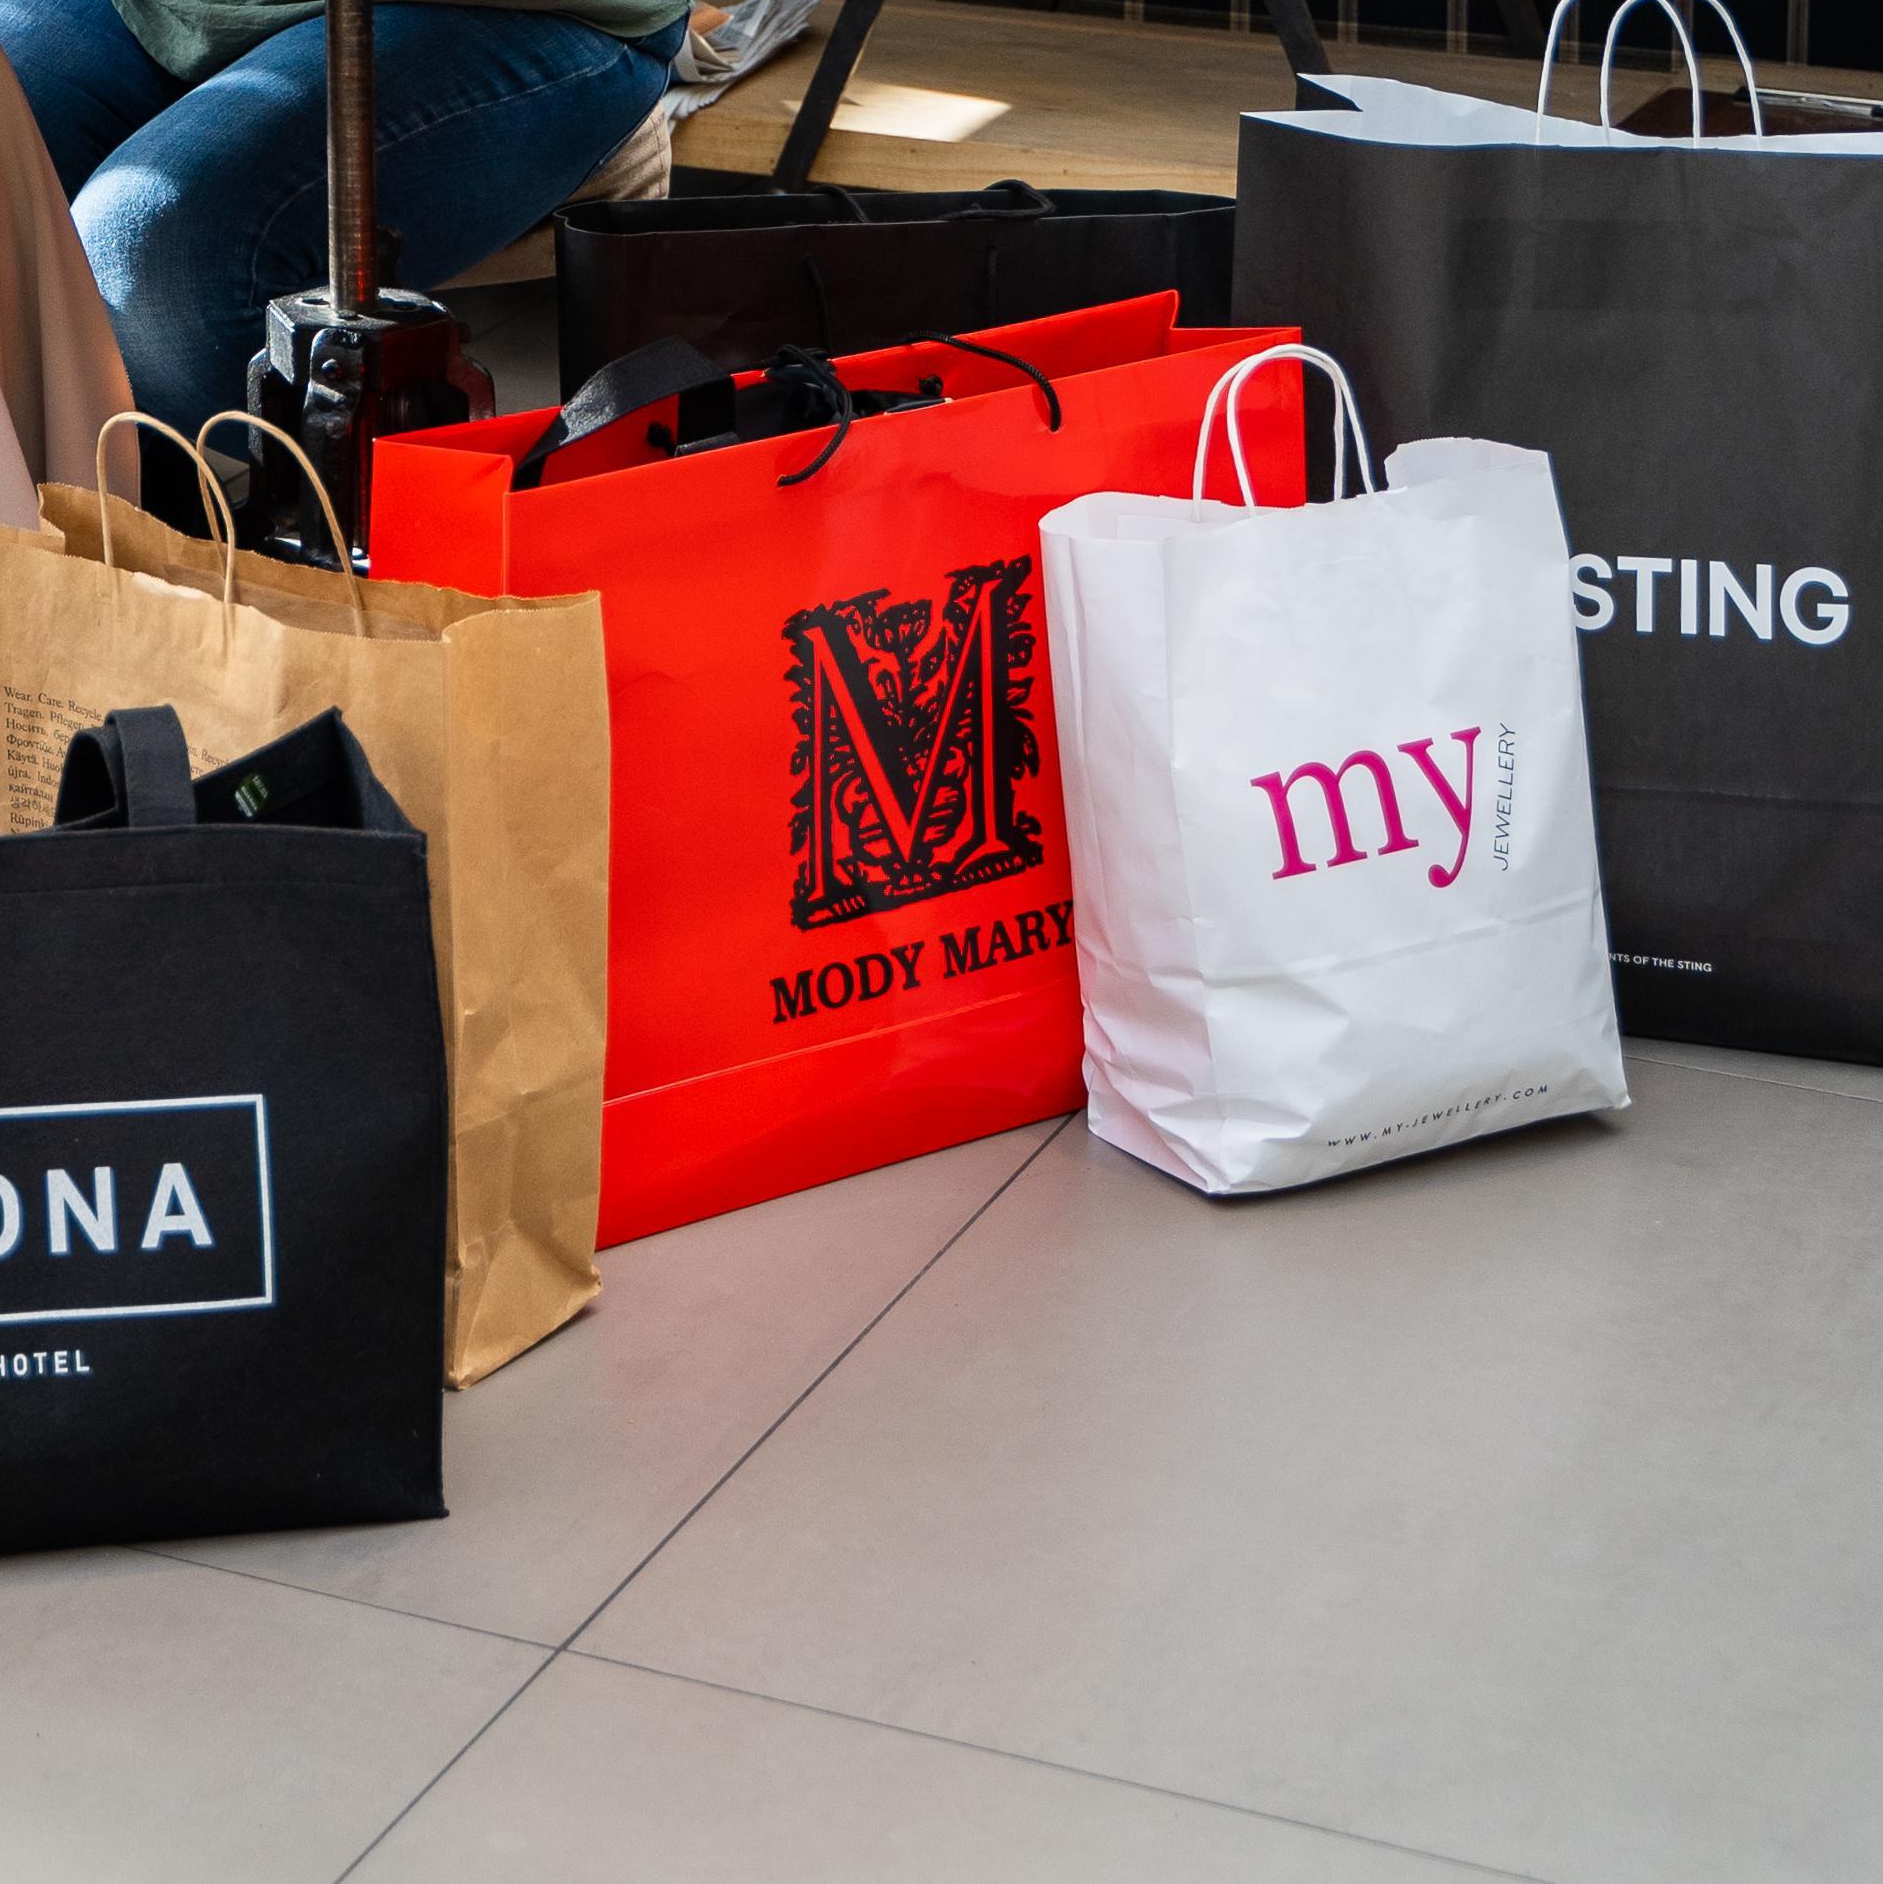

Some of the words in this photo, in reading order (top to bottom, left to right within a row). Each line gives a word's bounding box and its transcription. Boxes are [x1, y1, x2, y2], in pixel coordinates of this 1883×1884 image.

[1569, 553, 1850, 645] STING
[4, 686, 33, 702] Wear.
[38, 692, 65, 709] Care.
[4, 702, 45, 720] Tragen.
[1250, 726, 1481, 888] my
[1493, 722, 1516, 872] JEWELLERY
[769, 941, 924, 1024] MODY
[940, 900, 1074, 980] MARY
[1608, 953, 1630, 963] NTS
[1633, 955, 1649, 965] OF
[1652, 957, 1674, 968] THE
[1677, 960, 1712, 973] STING
